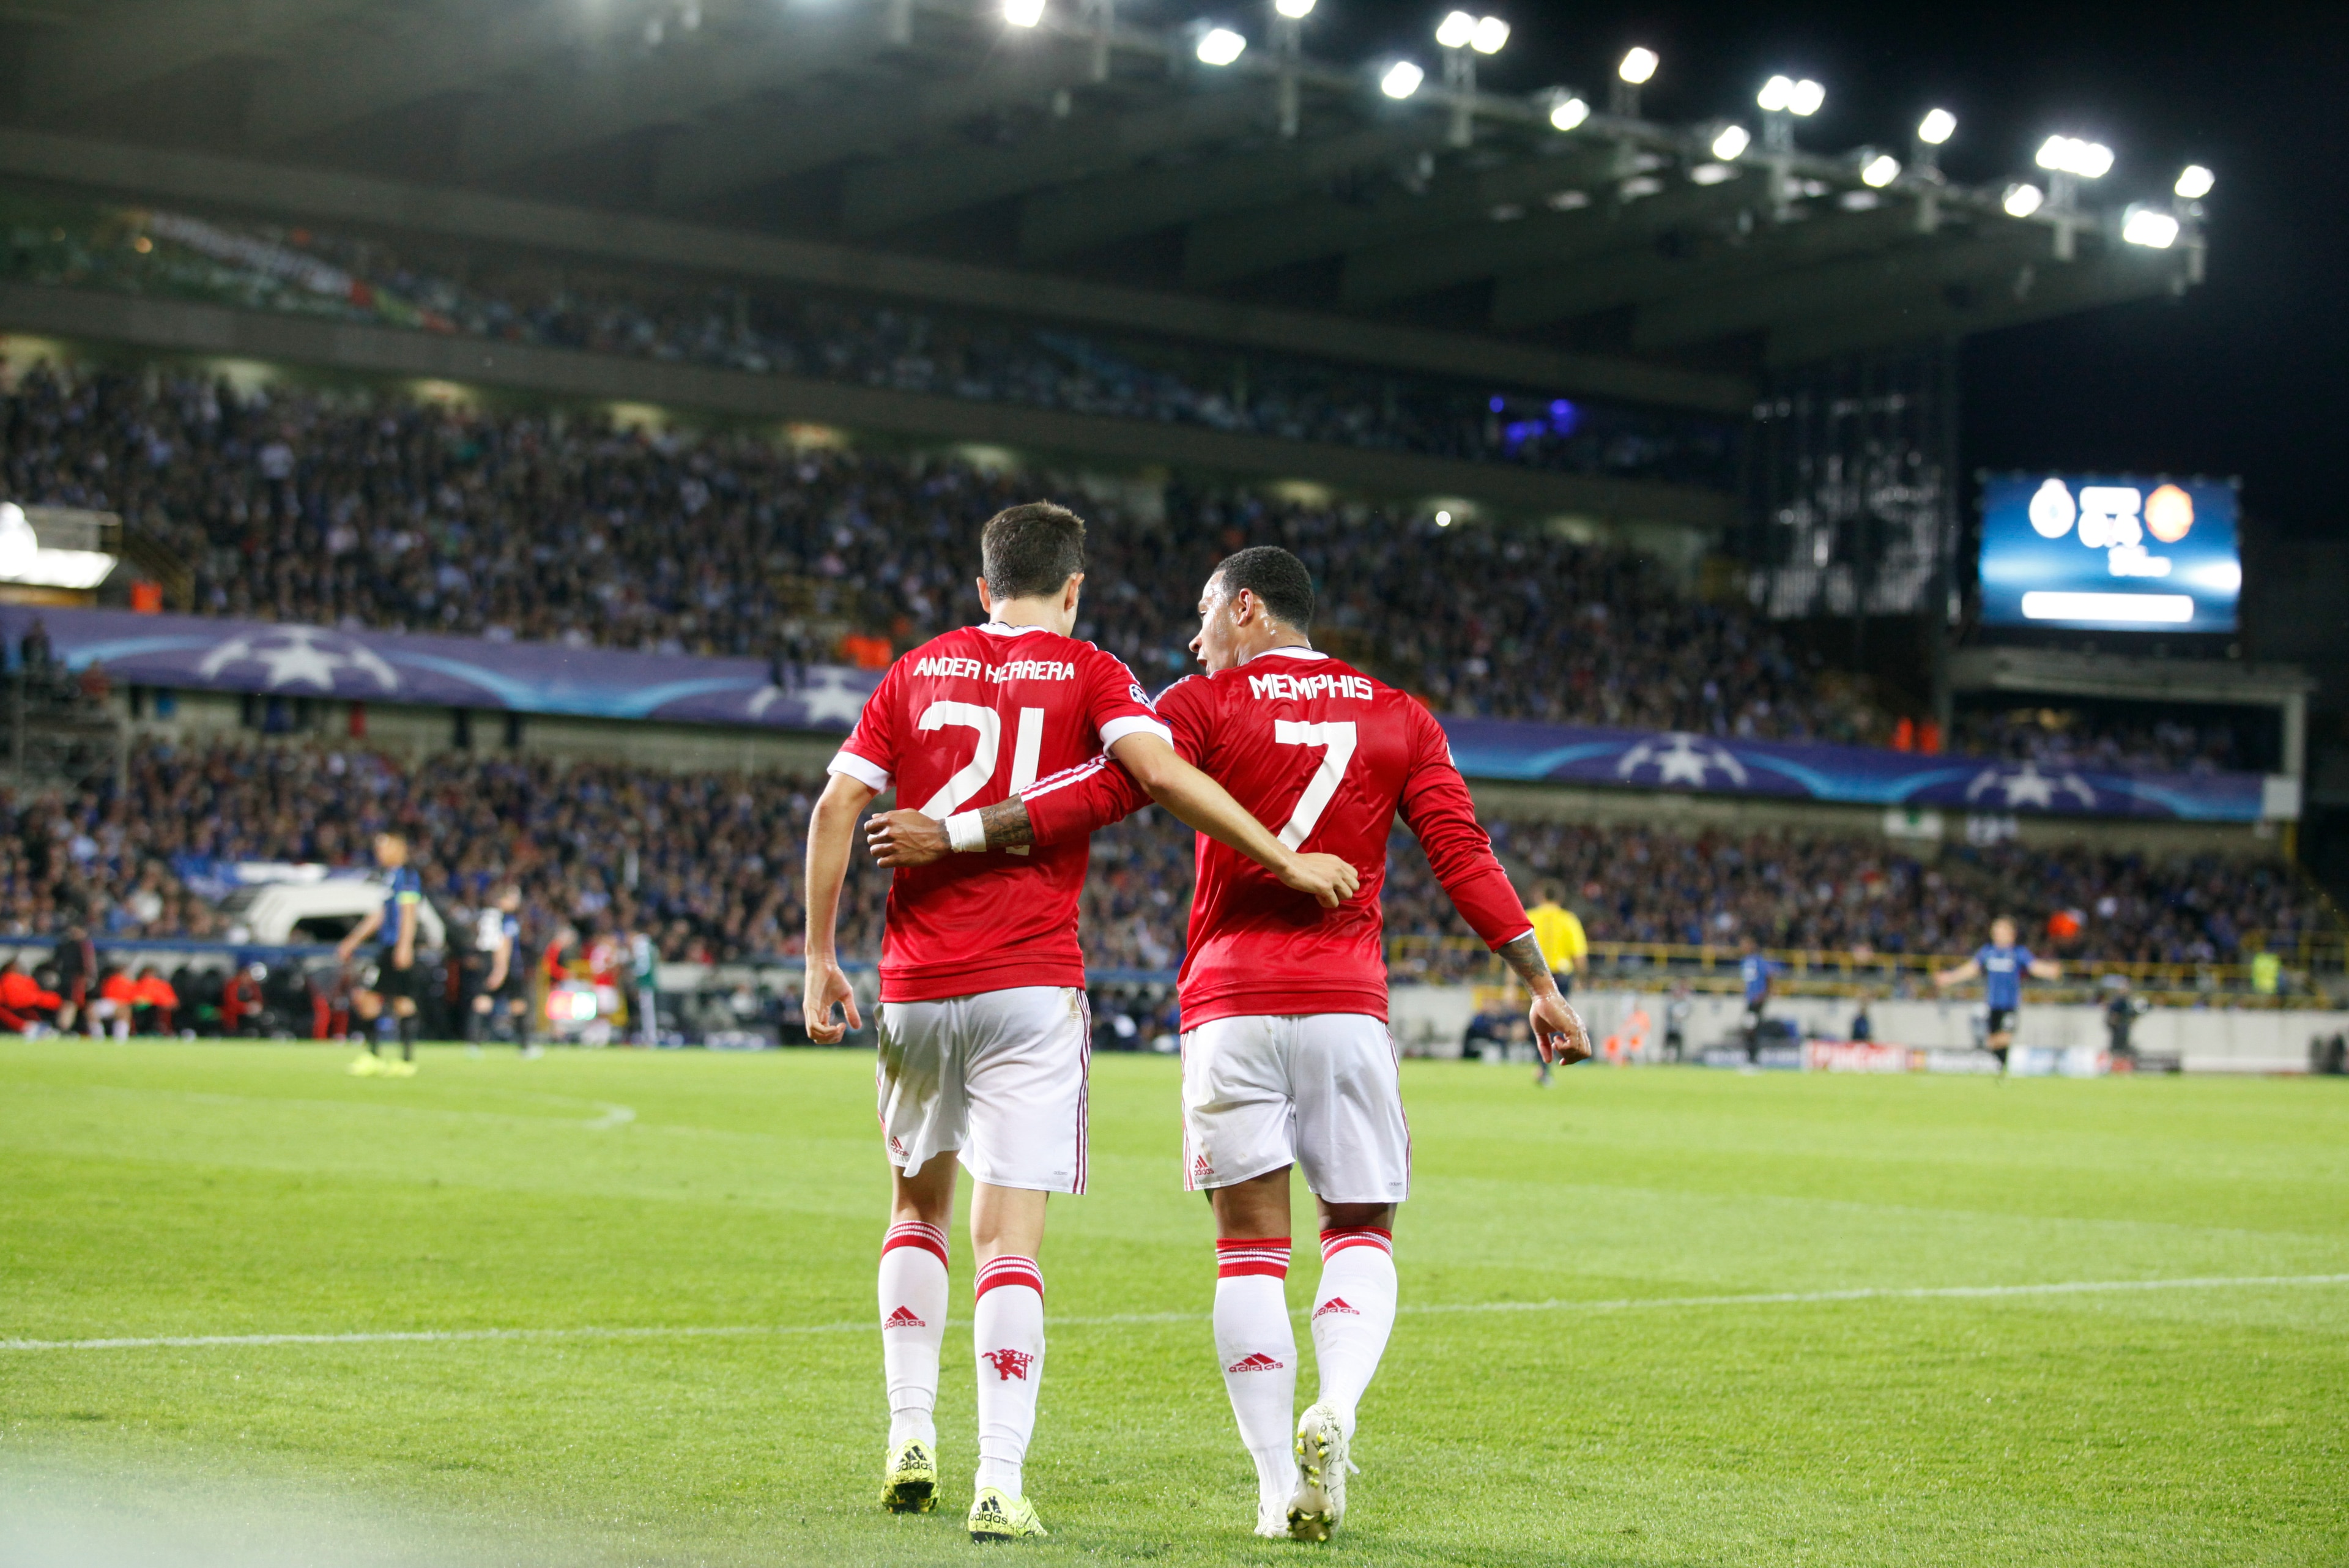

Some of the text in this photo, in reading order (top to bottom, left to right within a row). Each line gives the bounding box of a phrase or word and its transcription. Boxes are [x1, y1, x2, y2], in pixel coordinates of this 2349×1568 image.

[913, 657, 1074, 684] ANDER HERRERA
[1248, 674, 1373, 700] MEMPHIS
[918, 700, 1044, 856] 21
[1275, 719, 1357, 853] 7
[1313, 1307, 1360, 1320] adidas
[884, 1319, 926, 1330] adidas
[1229, 1362, 1283, 1372] adidas
[896, 1460, 933, 1473] adidas
[970, 1510, 1008, 1525] adidas
